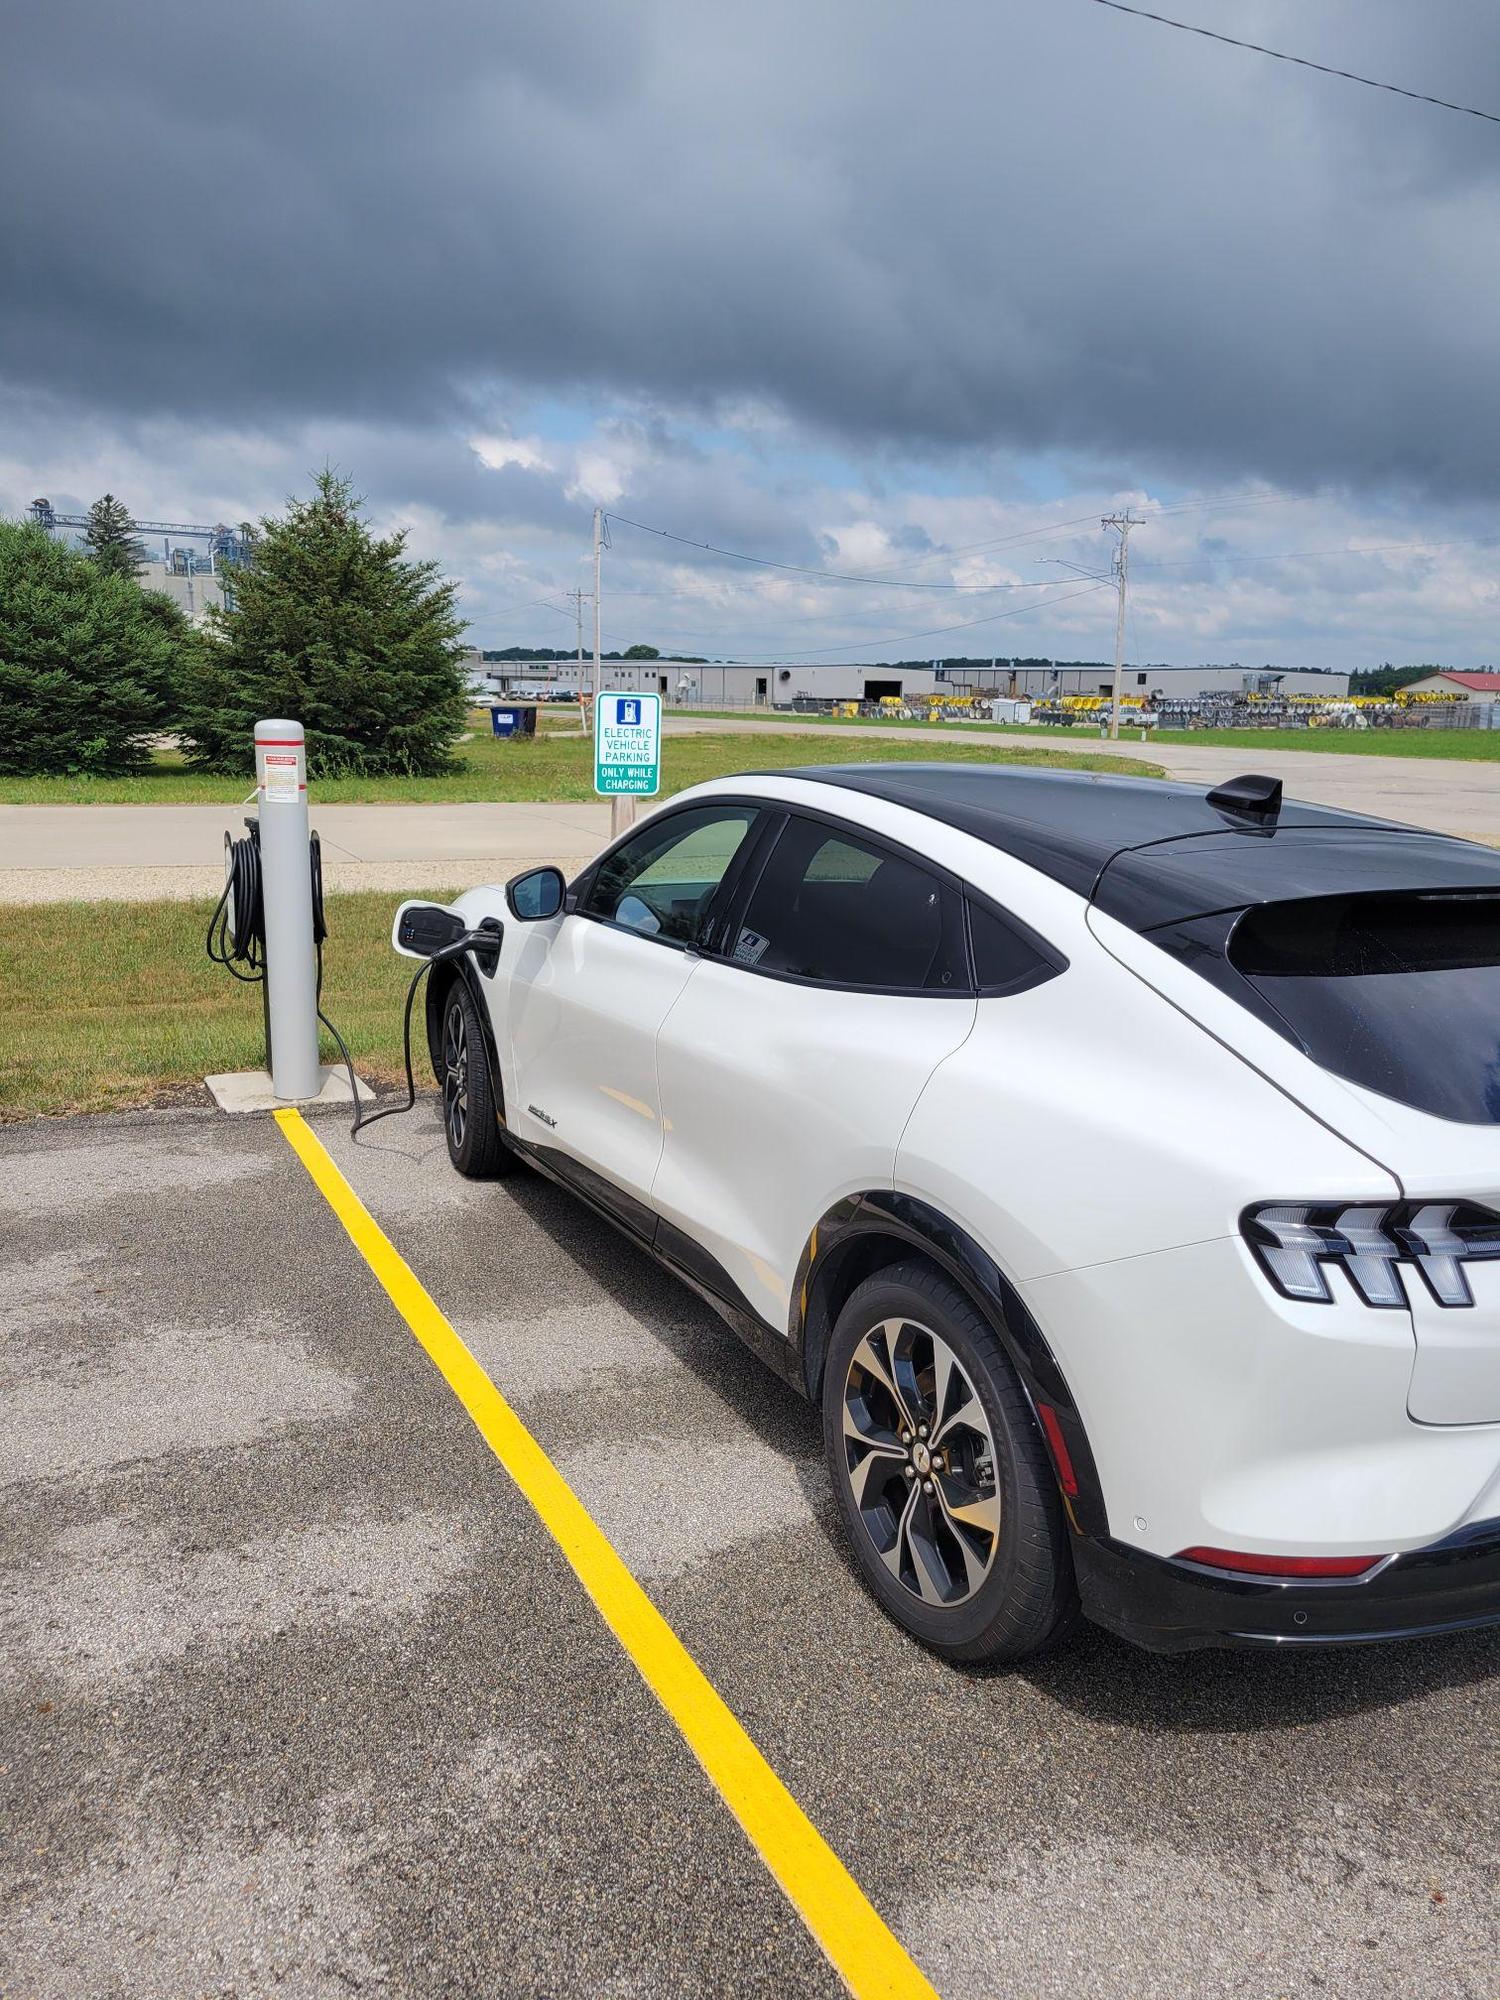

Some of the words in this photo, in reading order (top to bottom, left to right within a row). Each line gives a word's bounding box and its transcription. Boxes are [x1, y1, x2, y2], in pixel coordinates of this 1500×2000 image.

[604, 728, 652, 738] ELECTRIC
[606, 741, 650, 751] VEHICLE
[605, 752, 650, 763] PARKING
[601, 768, 625, 778] ONLY
[627, 768, 653, 778] WHILE
[605, 779, 649, 790] CHARGING
